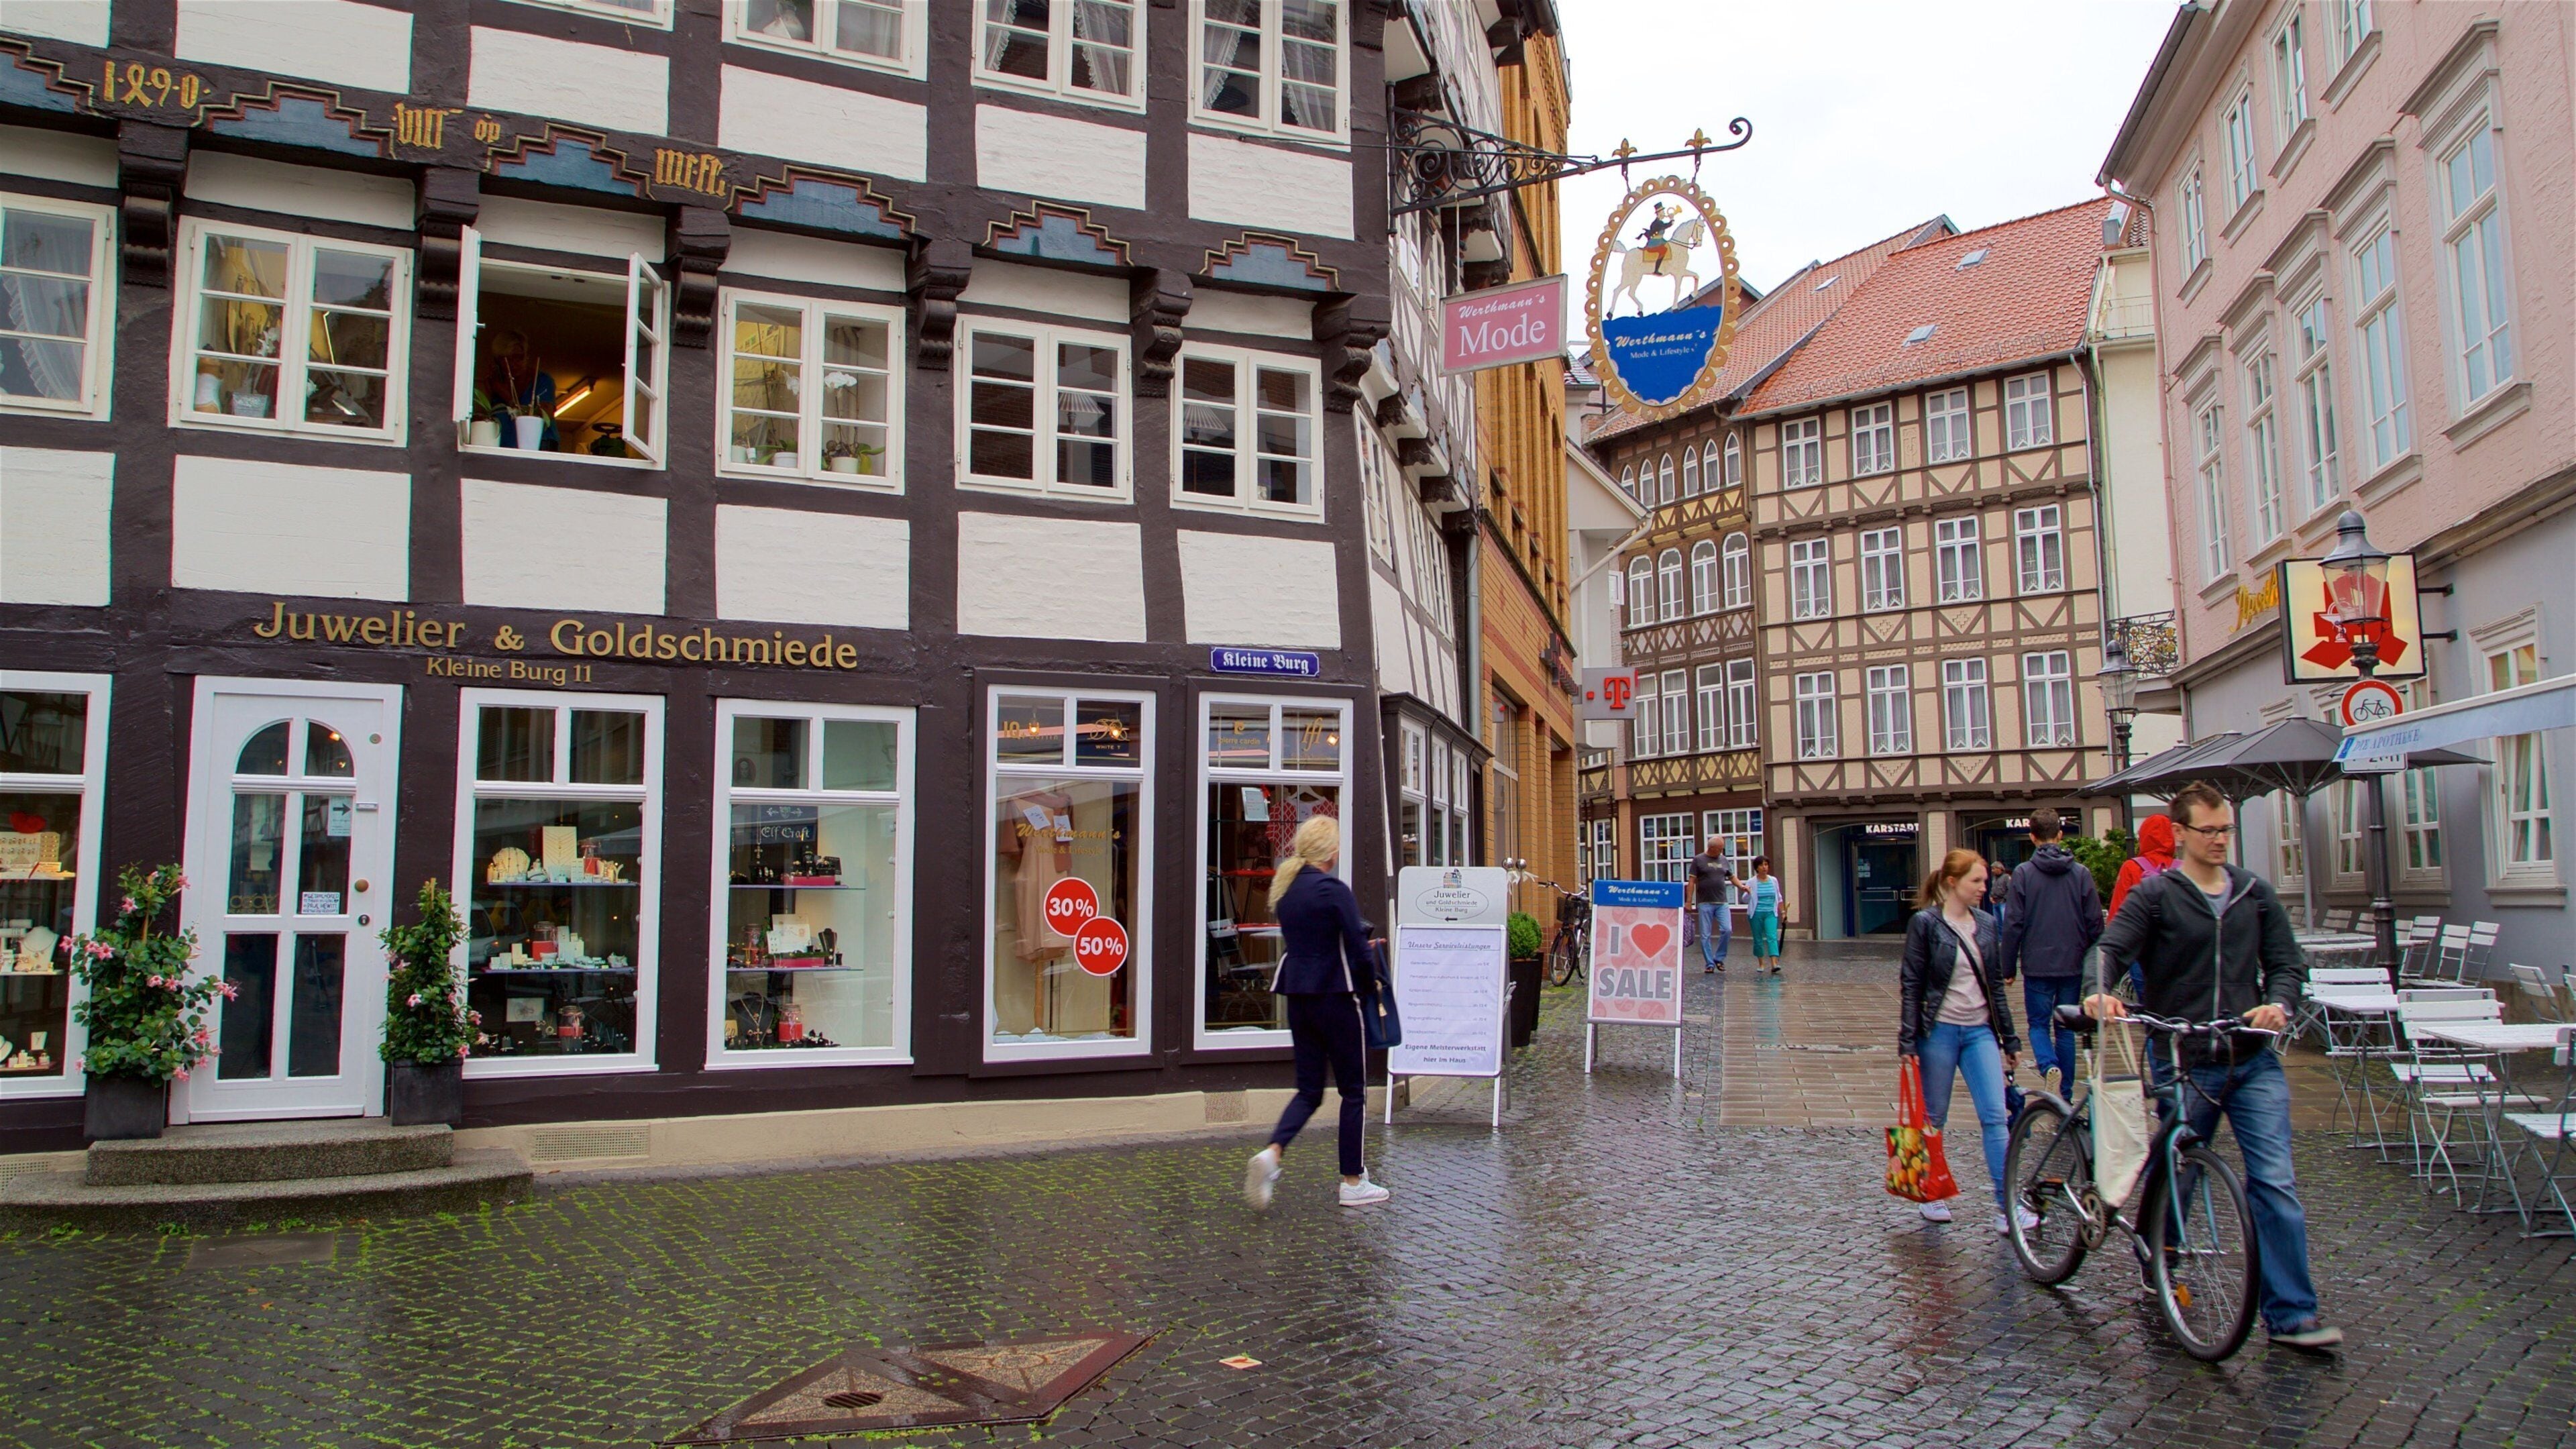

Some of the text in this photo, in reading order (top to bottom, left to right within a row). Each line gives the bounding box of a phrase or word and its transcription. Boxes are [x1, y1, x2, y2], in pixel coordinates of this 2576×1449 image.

[1458, 313, 1546, 357] Mode
[1630, 350, 1649, 359] Mode
[1660, 347, 1690, 356] Lifestyle
[253, 602, 858, 669] Juwelier & Goldschmiede
[426, 657, 592, 686] Kleine Burg 11
[1223, 651, 1309, 675] Kleine Burg
[761, 826, 780, 841] Elf
[1866, 823, 1919, 833] KARSTADT
[1434, 890, 1470, 899] Juwelier
[1049, 897, 1094, 917] 30%
[1079, 936, 1123, 956] 50%
[1434, 942, 1491, 951] Serviceleistungen
[1610, 926, 1619, 954] I
[1599, 968, 1671, 999] SALE
